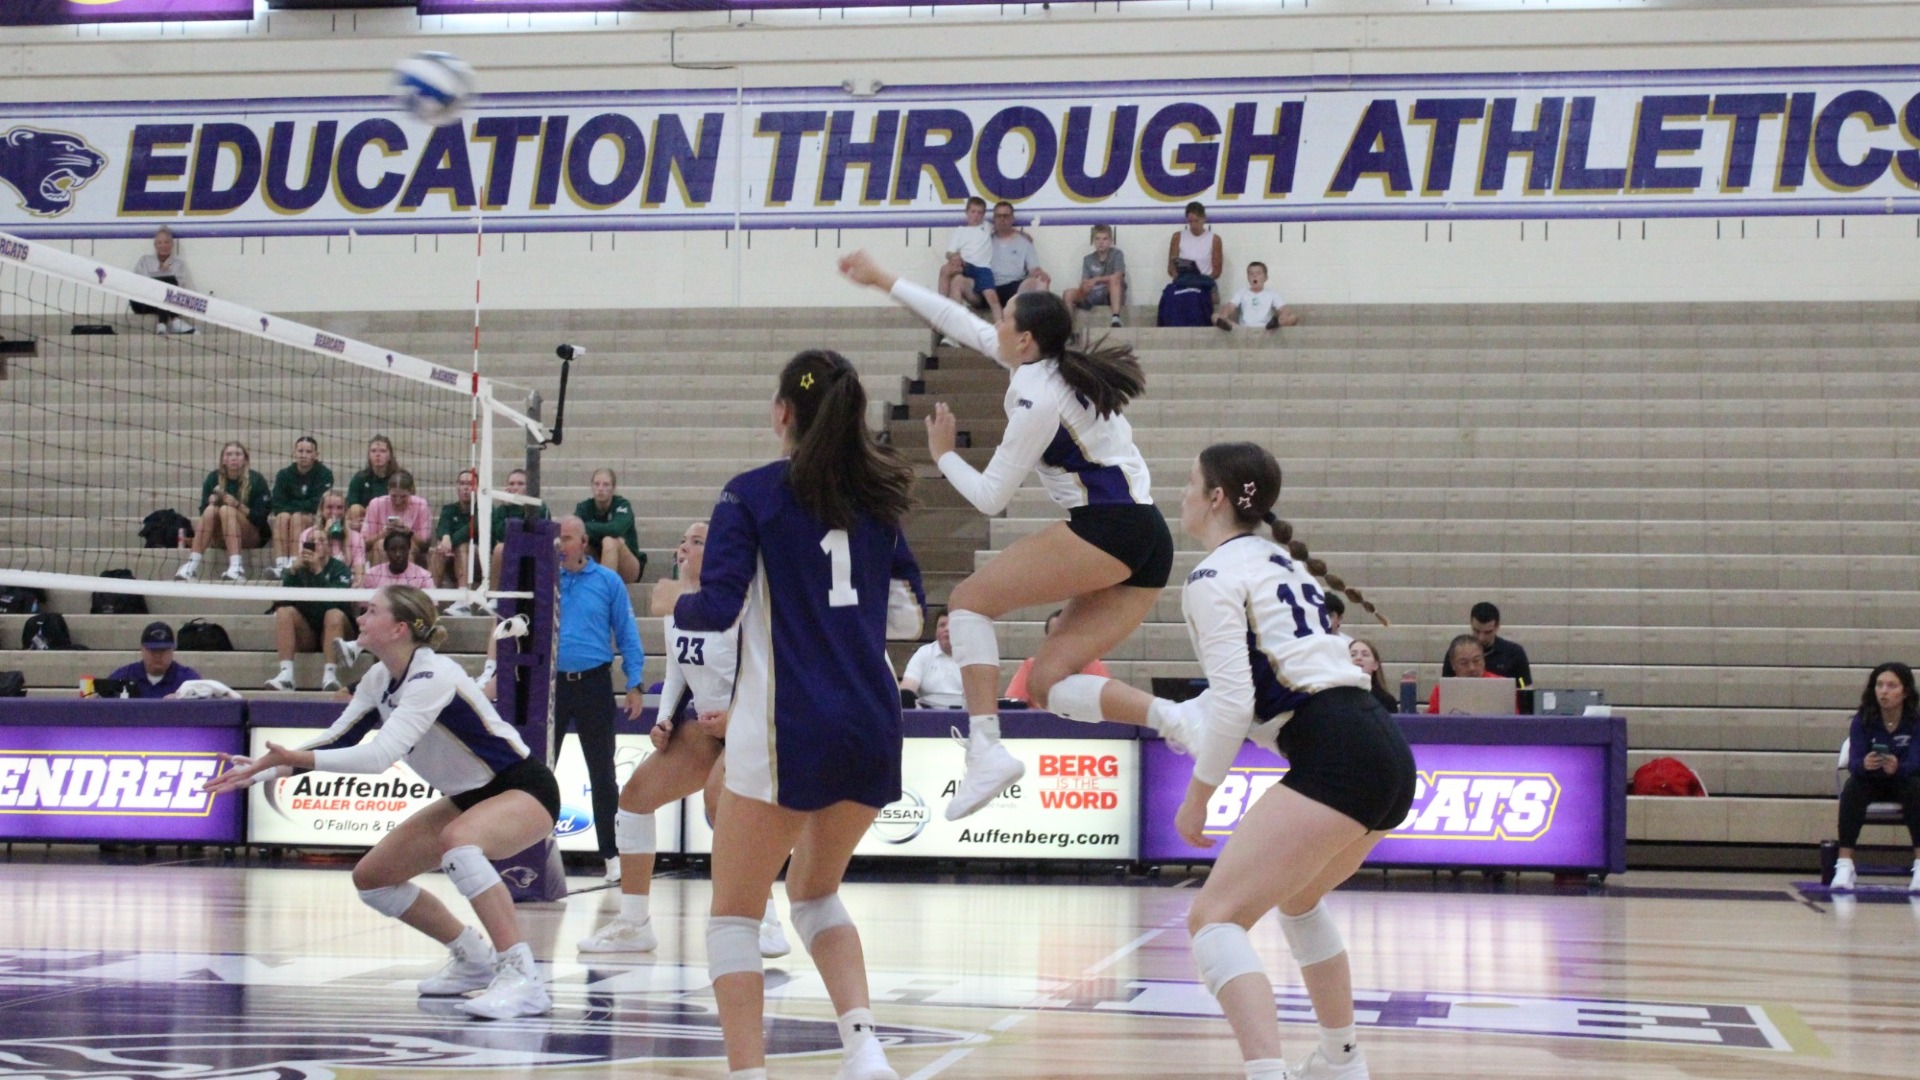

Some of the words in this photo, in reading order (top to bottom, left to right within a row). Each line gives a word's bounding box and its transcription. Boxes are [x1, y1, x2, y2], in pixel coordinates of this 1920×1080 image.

[117, 113, 724, 216] EDUCATION
[753, 101, 1304, 207] THROUGH
[820, 528, 859, 607] 1
[676, 636, 706, 667] 23
[1039, 754, 1119, 777] BERG
[292, 776, 445, 799] Auffenber
[1056, 777, 1069, 790] IS
[1073, 777, 1100, 790] THE
[292, 799, 350, 811] DEALER
[354, 800, 408, 812] GROUP
[1040, 791, 1118, 810] WORD
[877, 809, 924, 819] ISSAN
[313, 818, 369, 832] O'Fallon
[371, 819, 383, 832] &
[958, 828, 1120, 848] Auffenberg.com
